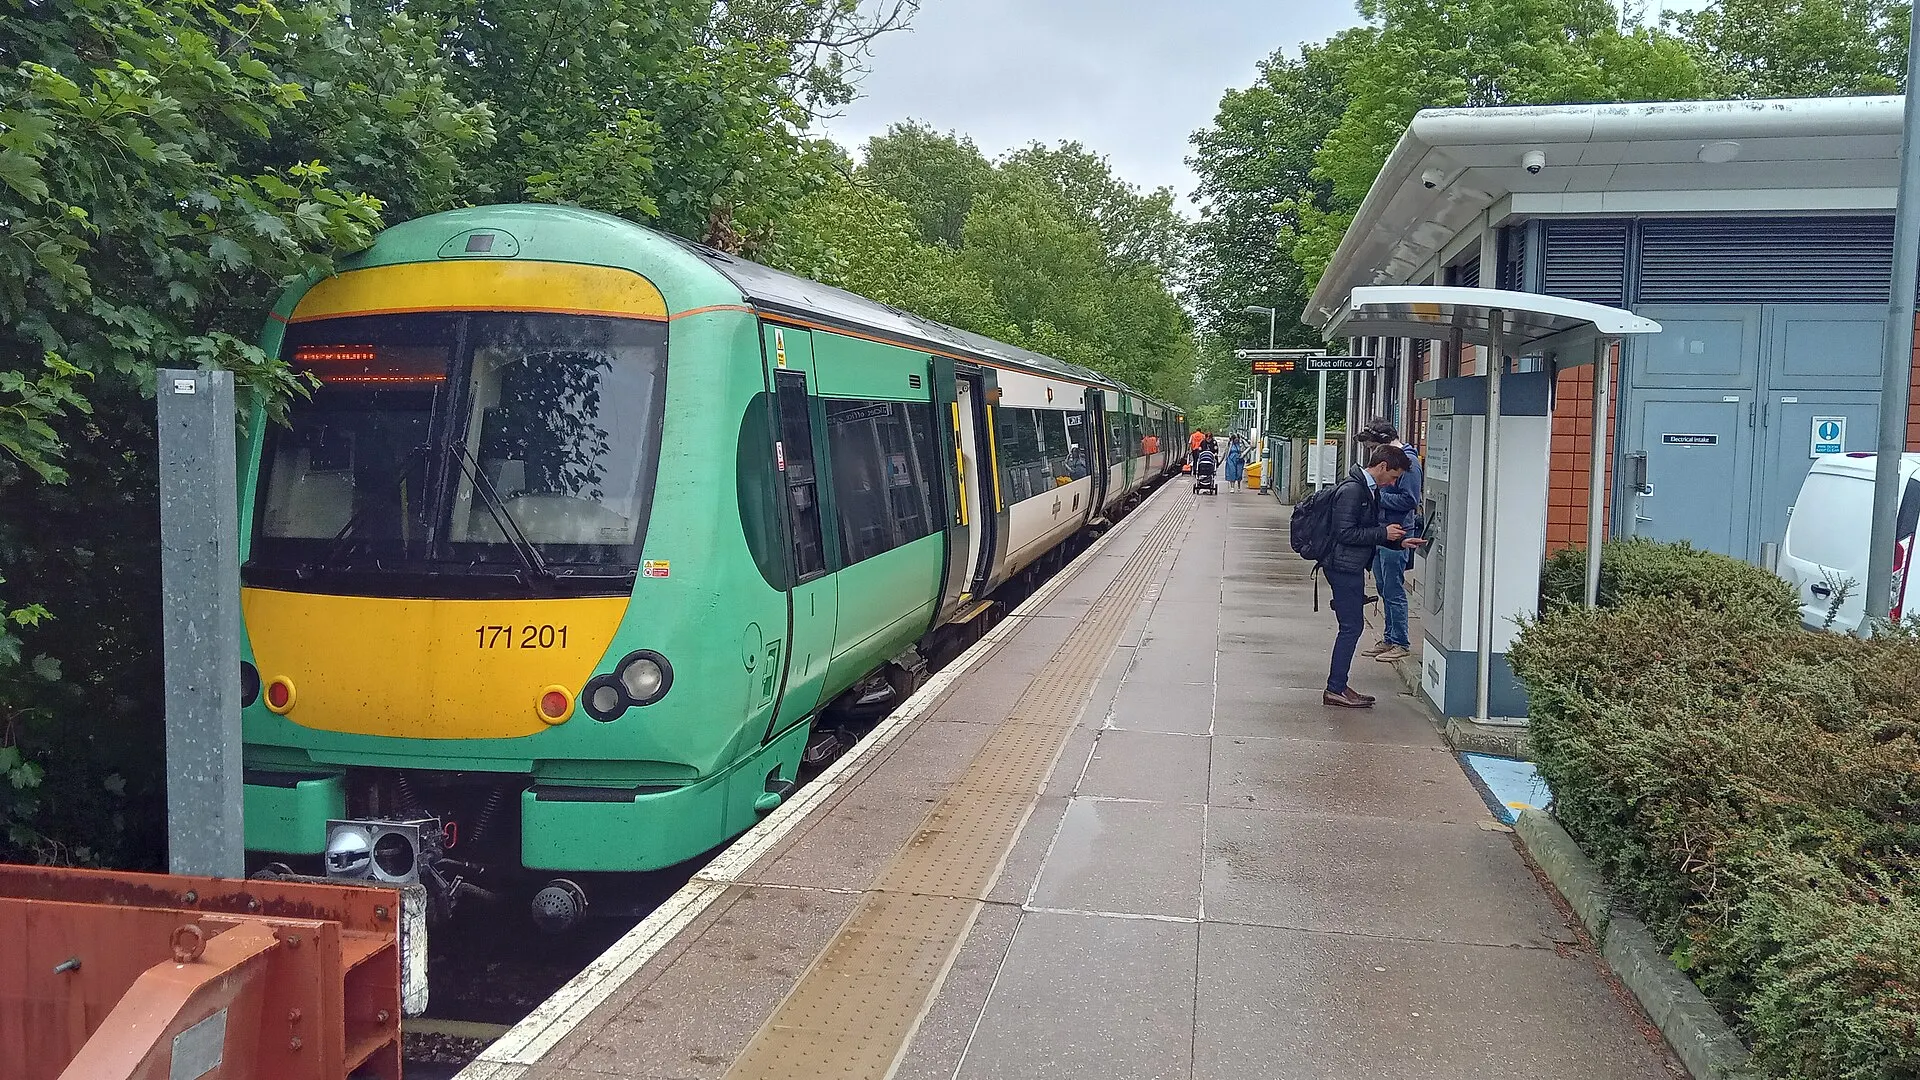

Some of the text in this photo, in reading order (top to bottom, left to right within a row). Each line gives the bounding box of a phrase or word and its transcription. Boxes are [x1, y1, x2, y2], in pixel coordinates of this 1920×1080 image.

[1310, 359, 1353, 368] Ticket office
[475, 624, 567, 648] 171 201
